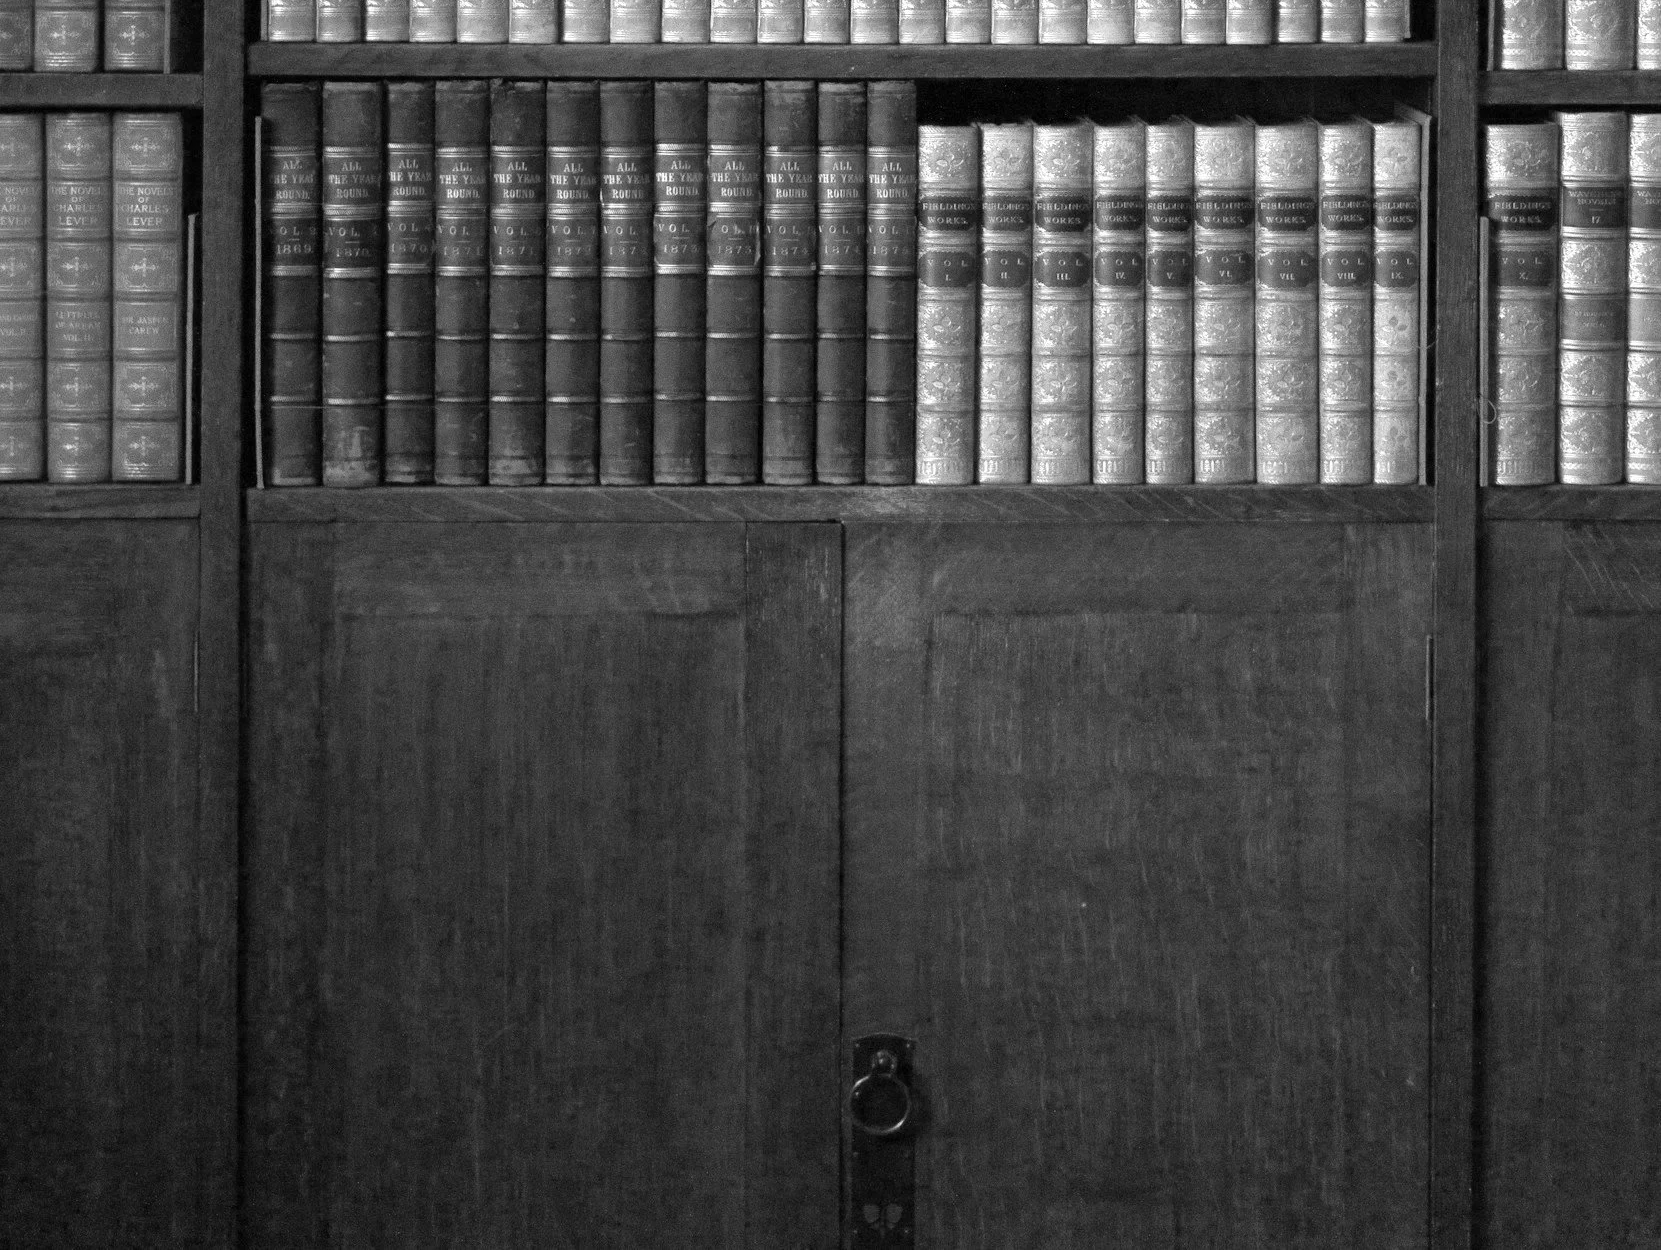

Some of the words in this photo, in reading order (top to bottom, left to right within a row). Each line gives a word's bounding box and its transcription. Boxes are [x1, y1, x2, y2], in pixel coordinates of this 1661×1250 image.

[341, 161, 362, 172] ALL
[399, 159, 419, 169] ALL
[452, 162, 474, 172] ALL
[507, 161, 528, 171] ALL
[563, 162, 584, 173] ALL
[616, 162, 638, 172] ALL
[671, 160, 692, 170] ALL
[724, 160, 745, 171] ALL
[780, 161, 800, 171] ALL
[832, 161, 853, 171] ALL
[882, 162, 902, 172] ALL
[329, 174, 349, 185] THE
[439, 175, 459, 185] THE
[493, 173, 513, 184] THE
[550, 174, 569, 185] THE
[603, 174, 623, 185] THE
[655, 172, 675, 183] THE
[711, 172, 731, 183] THE
[766, 173, 785, 184] THE
[818, 173, 837, 184] THE
[869, 174, 888, 184] THE
[58, 216, 98, 226] LEVER
[126, 216, 164, 227] LEVER
[1590, 215, 1601, 224] 17
